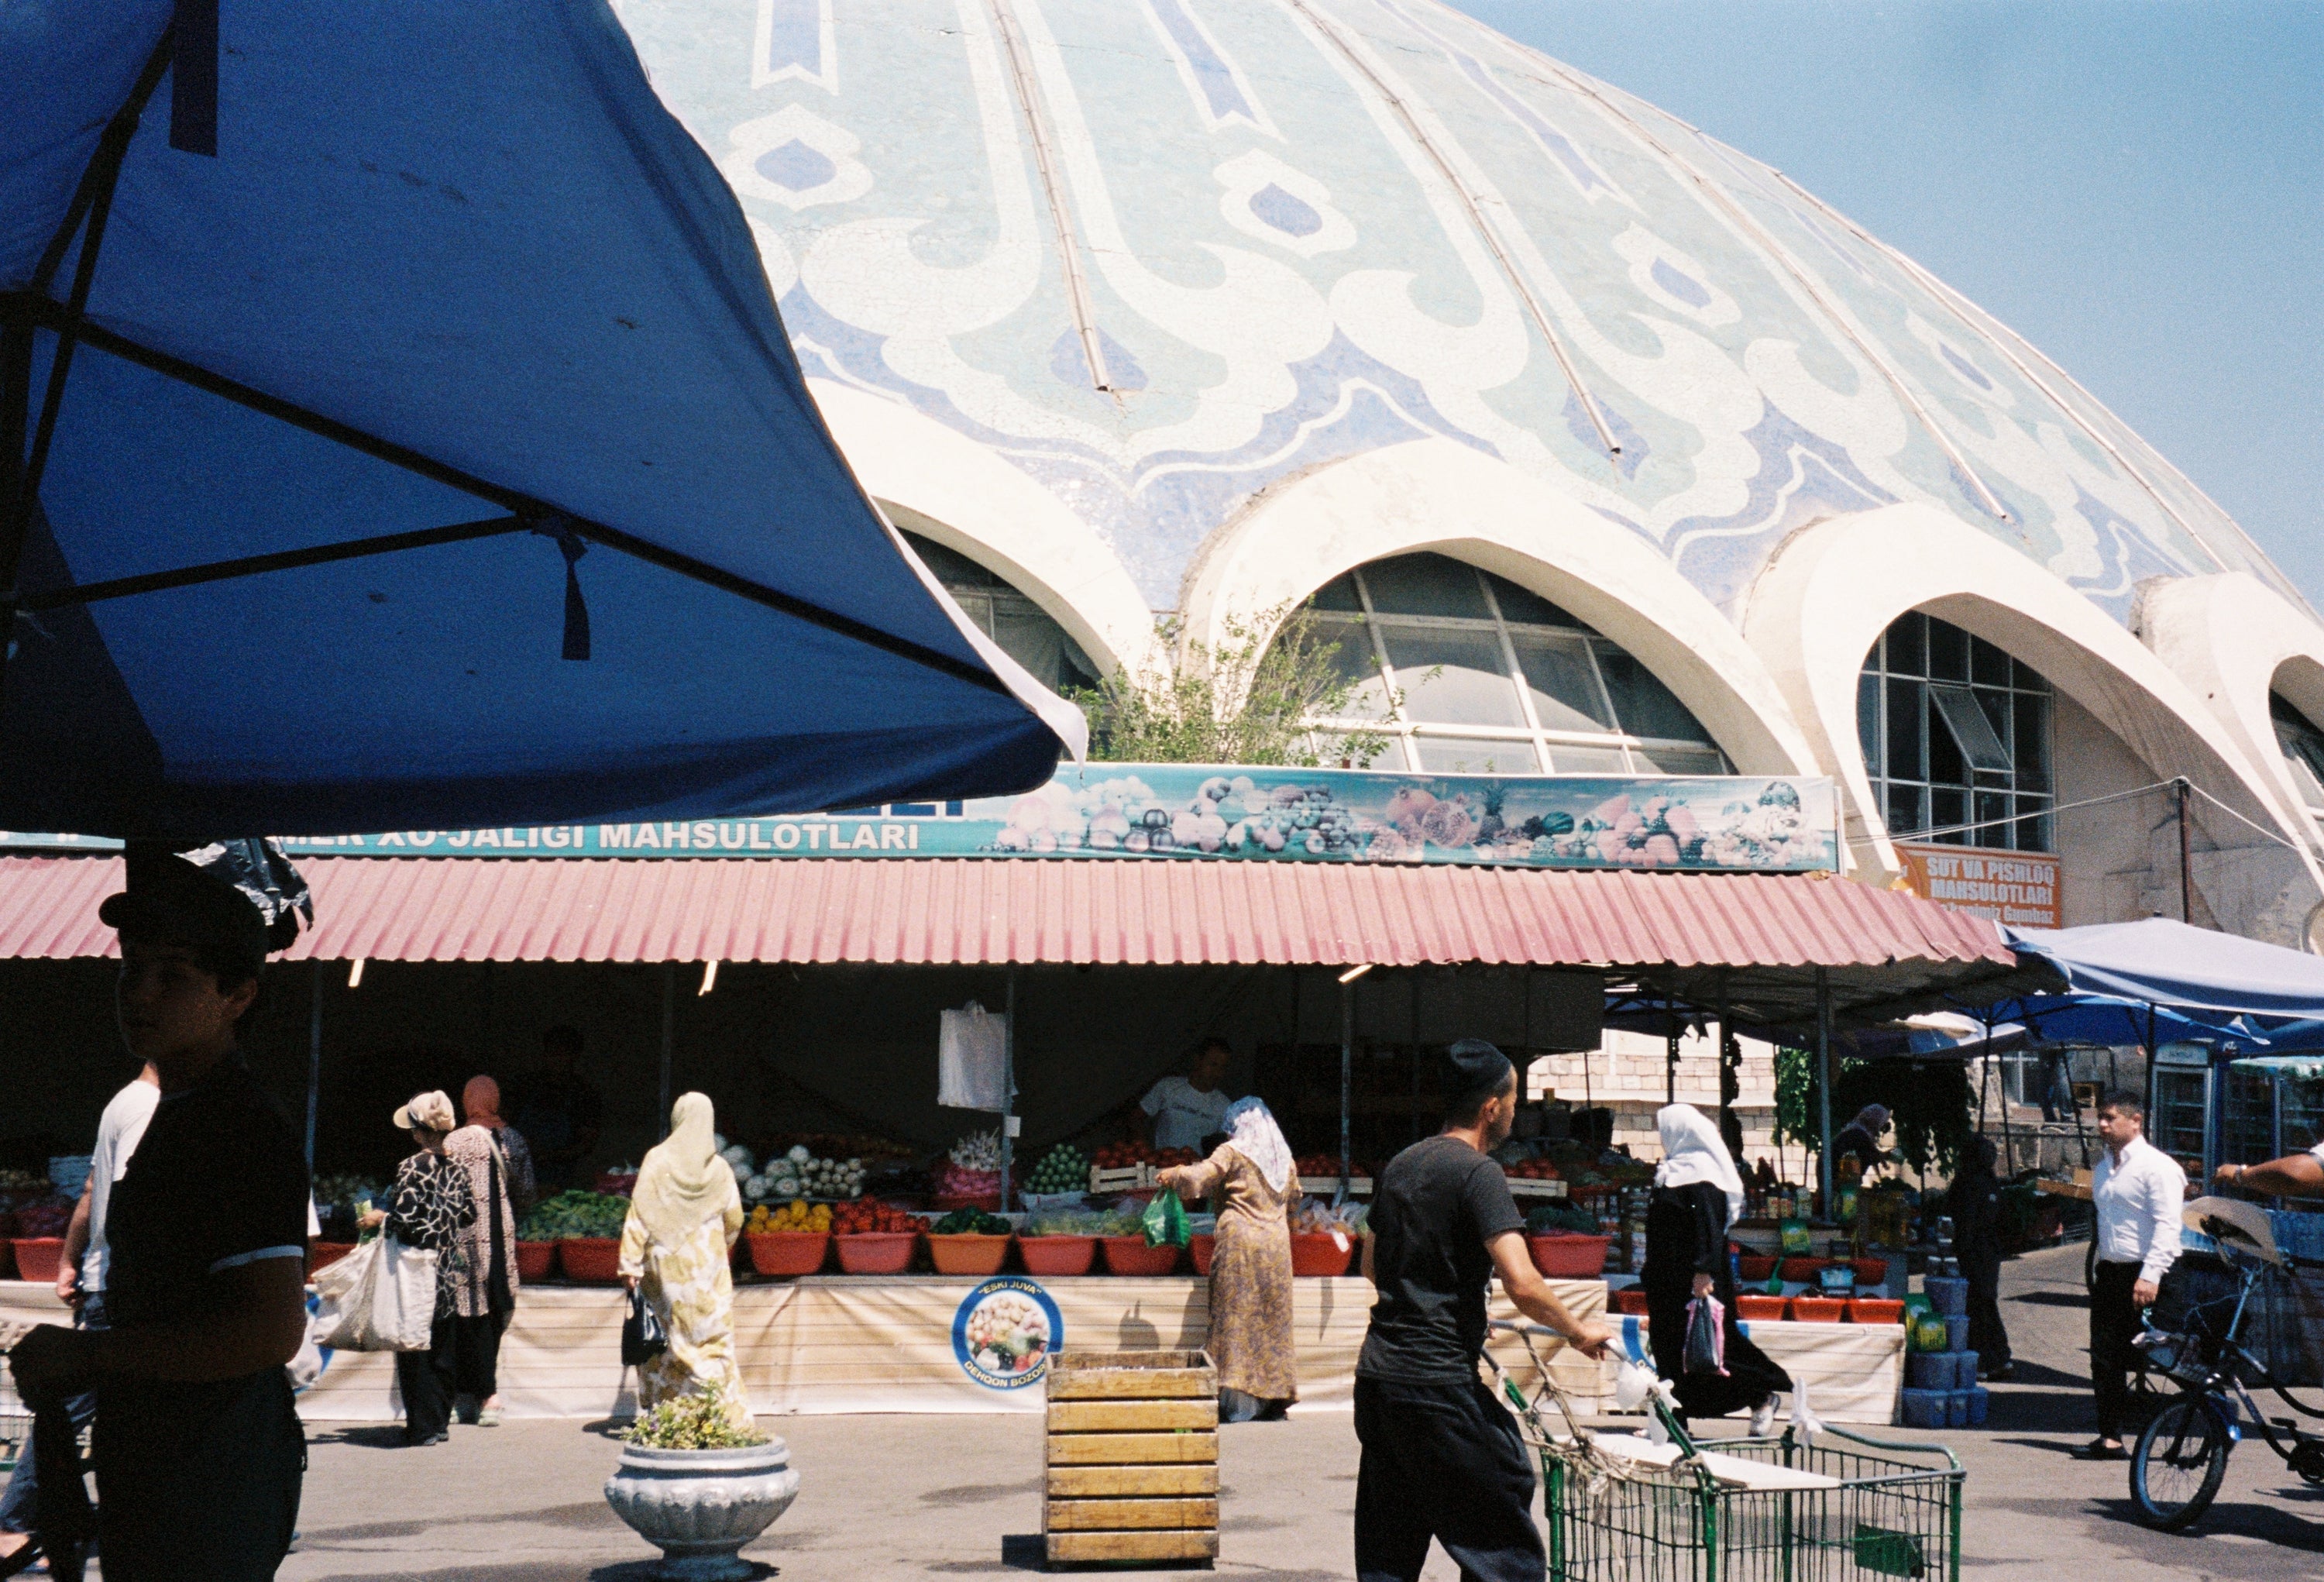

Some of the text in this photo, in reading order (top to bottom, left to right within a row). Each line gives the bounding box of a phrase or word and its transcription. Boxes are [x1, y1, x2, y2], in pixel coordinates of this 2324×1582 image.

[600, 823, 919, 850] MAHSULOTLARI
[1927, 856, 1958, 877] SUT
[1962, 860, 1983, 879] VA
[1988, 862, 2054, 886] PISHLOQ
[1931, 879, 2052, 905] MAHSULOTLARI
